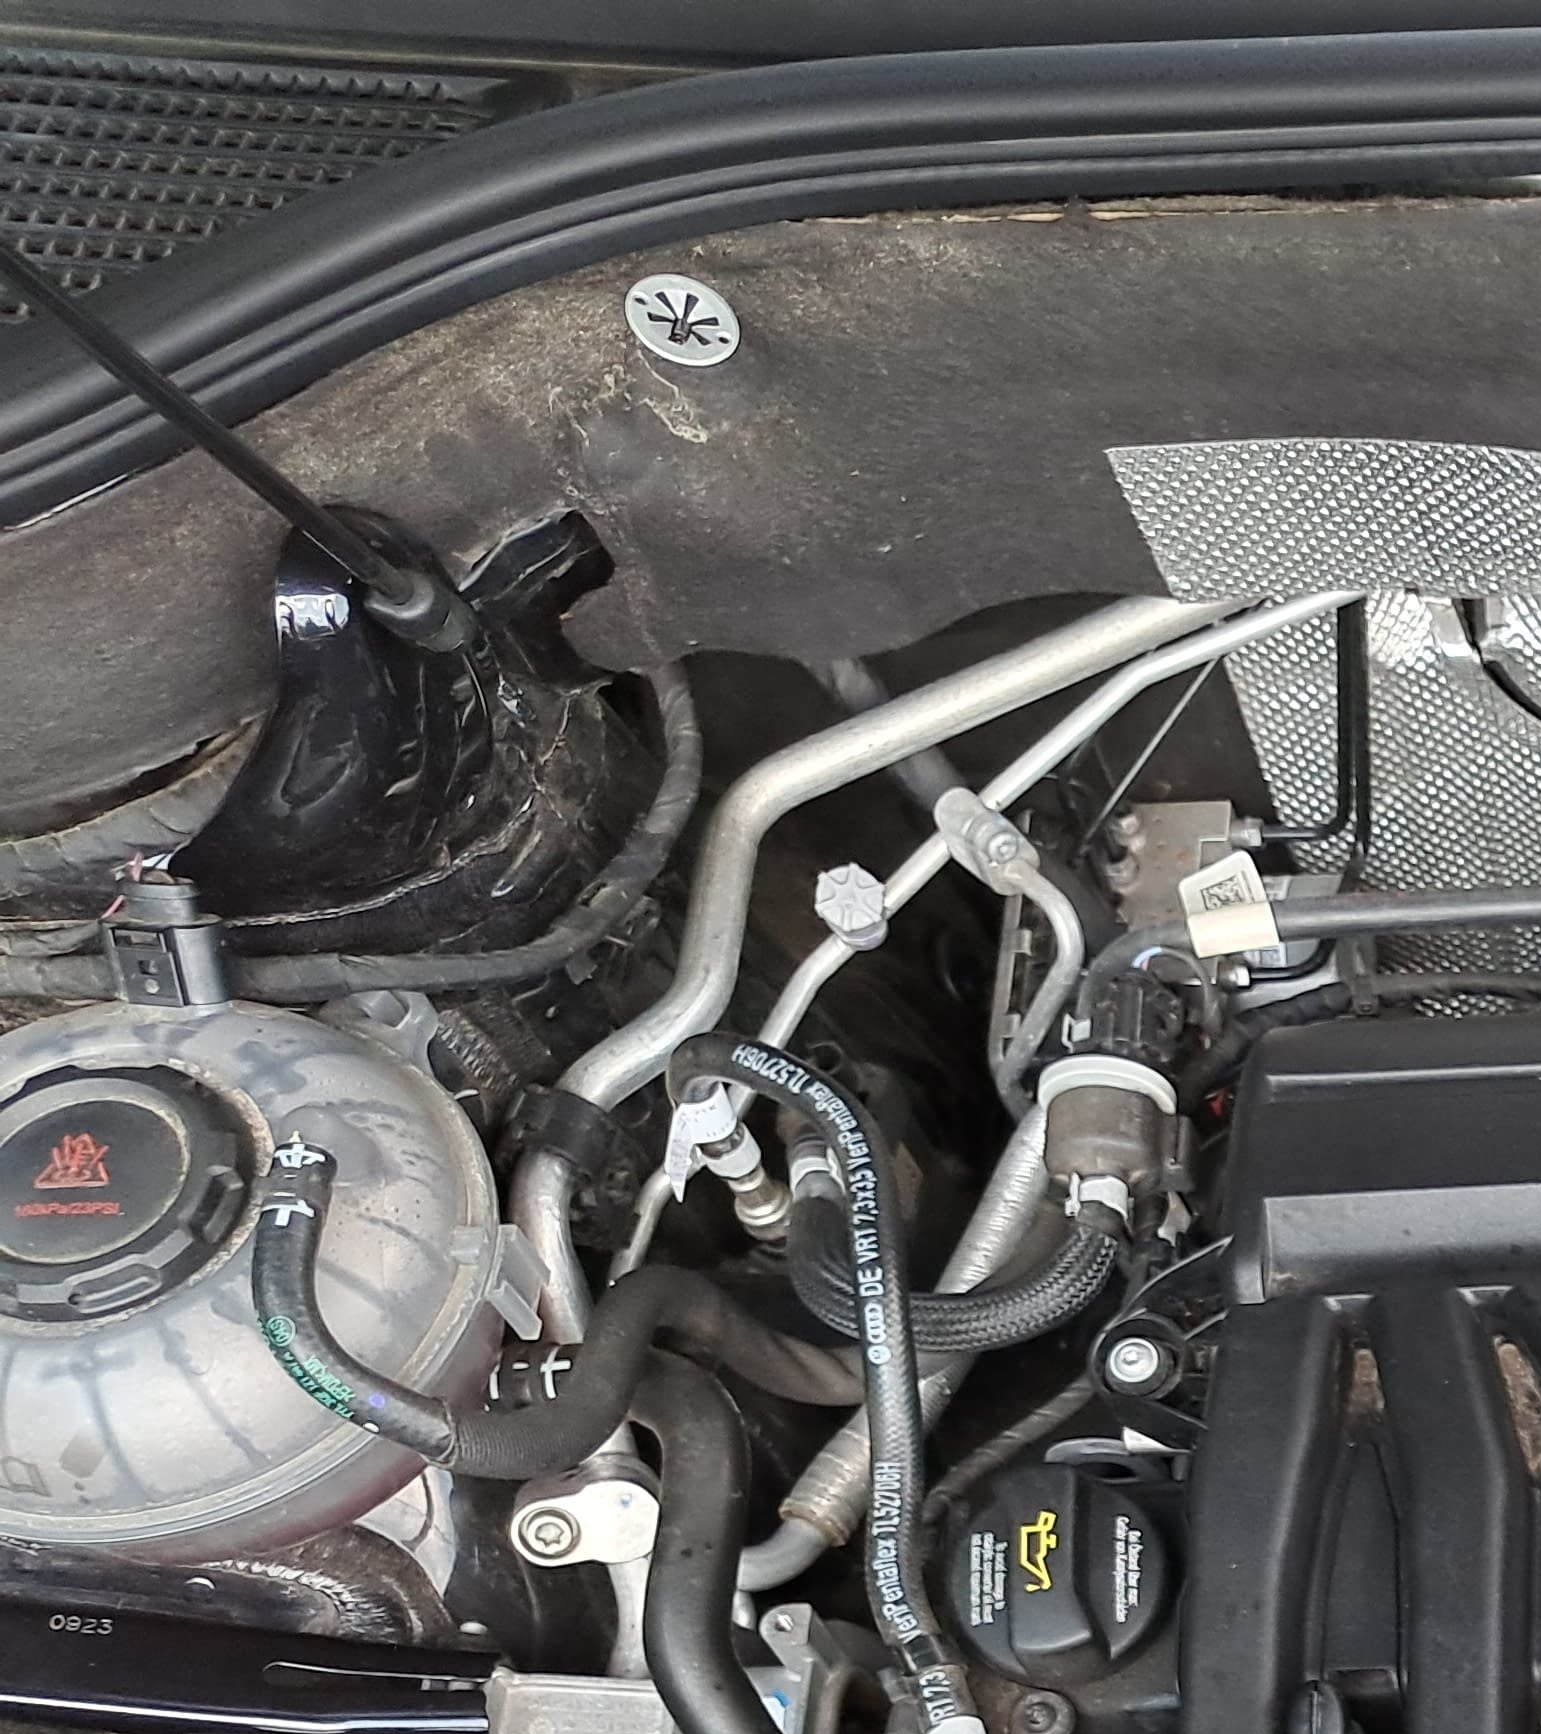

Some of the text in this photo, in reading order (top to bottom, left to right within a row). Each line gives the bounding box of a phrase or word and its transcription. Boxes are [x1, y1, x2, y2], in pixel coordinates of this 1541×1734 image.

[731, 1044, 810, 1094] TL52706H
[855, 1231, 881, 1264] VRT
[858, 1267, 885, 1297] DE
[872, 1462, 904, 1540] TL52706H
[48, 1614, 114, 1635] 0923
